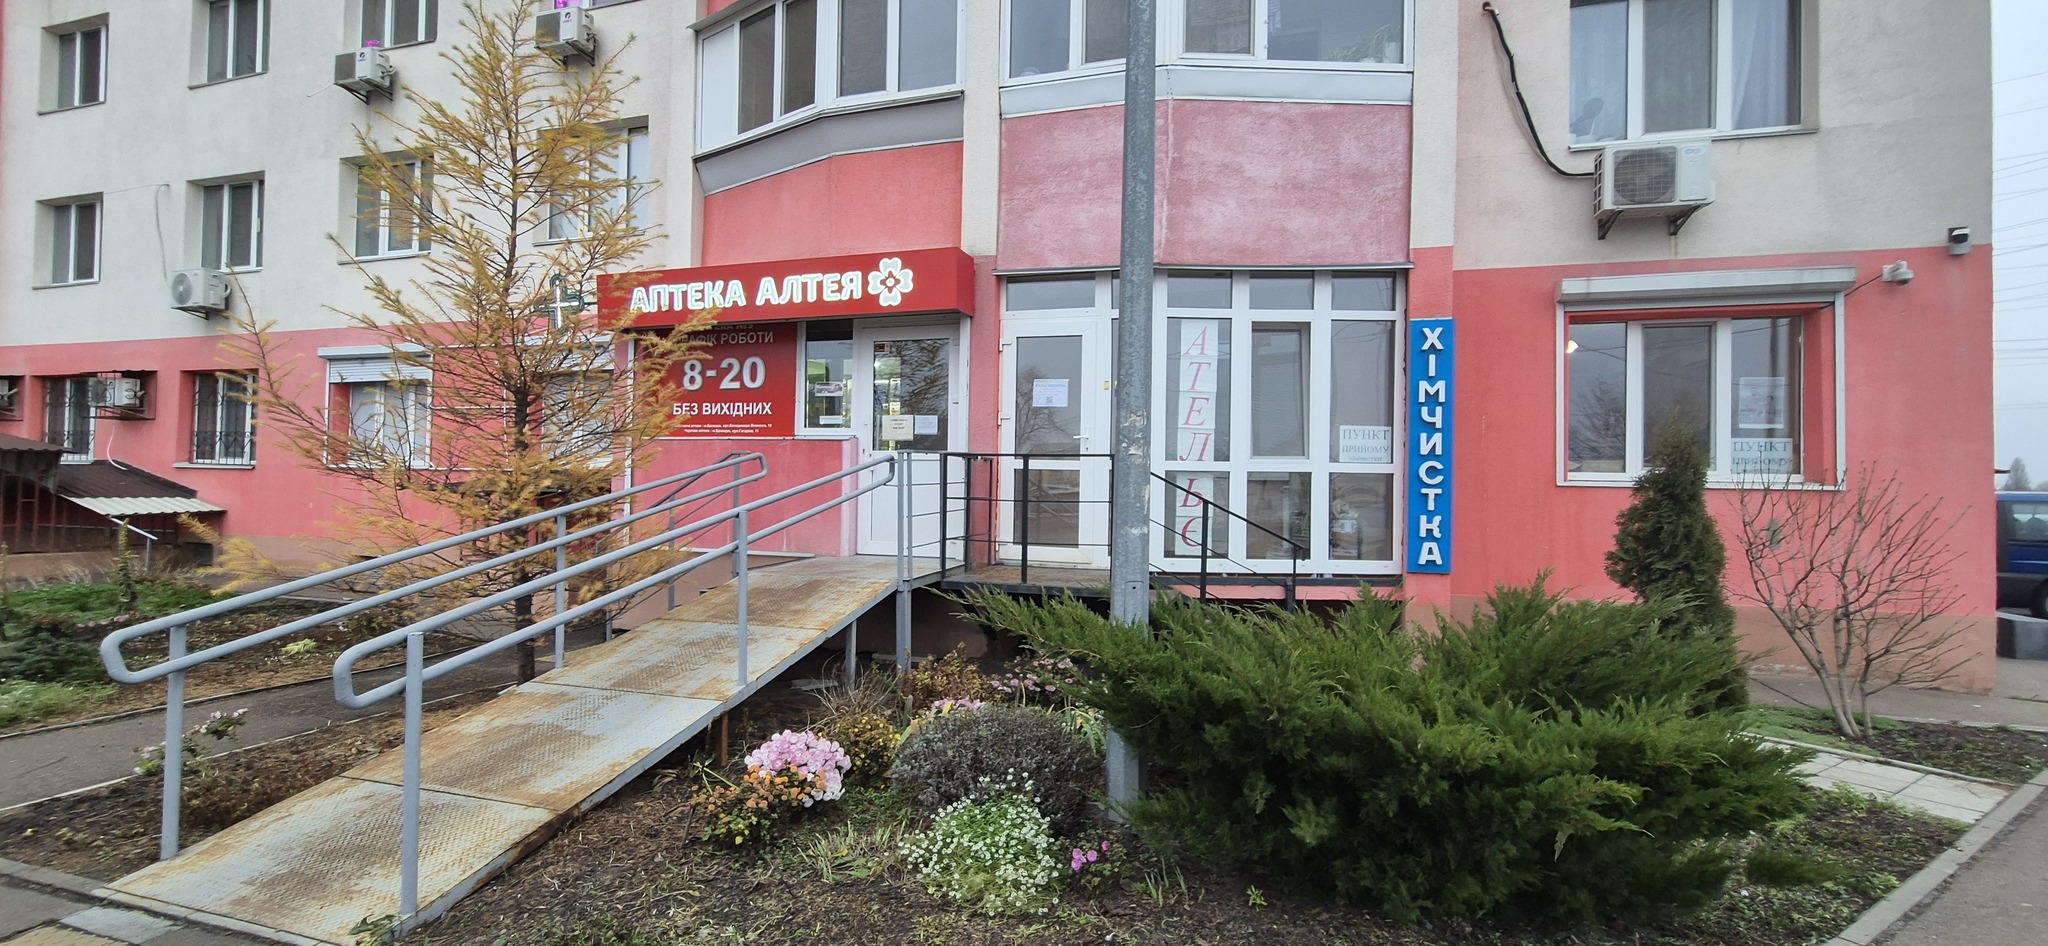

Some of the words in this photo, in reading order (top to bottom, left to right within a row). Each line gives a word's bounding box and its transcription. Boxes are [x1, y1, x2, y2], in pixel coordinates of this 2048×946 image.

[630, 281, 747, 313] АПТЕКА
[756, 272, 862, 305] АЛТЕЯ
[721, 332, 773, 344] РОБОТИ
[682, 356, 766, 391] 8-20
[673, 402, 699, 416] БЕЗ
[702, 402, 772, 417] ВИХІДНИХ
[1179, 326, 1212, 548] АТЕЛЬЄ
[1343, 429, 1390, 440] ПУНКТ
[1417, 327, 1446, 565] ХІМЧИСТКА
[1733, 441, 1791, 452] ПУНКТ
